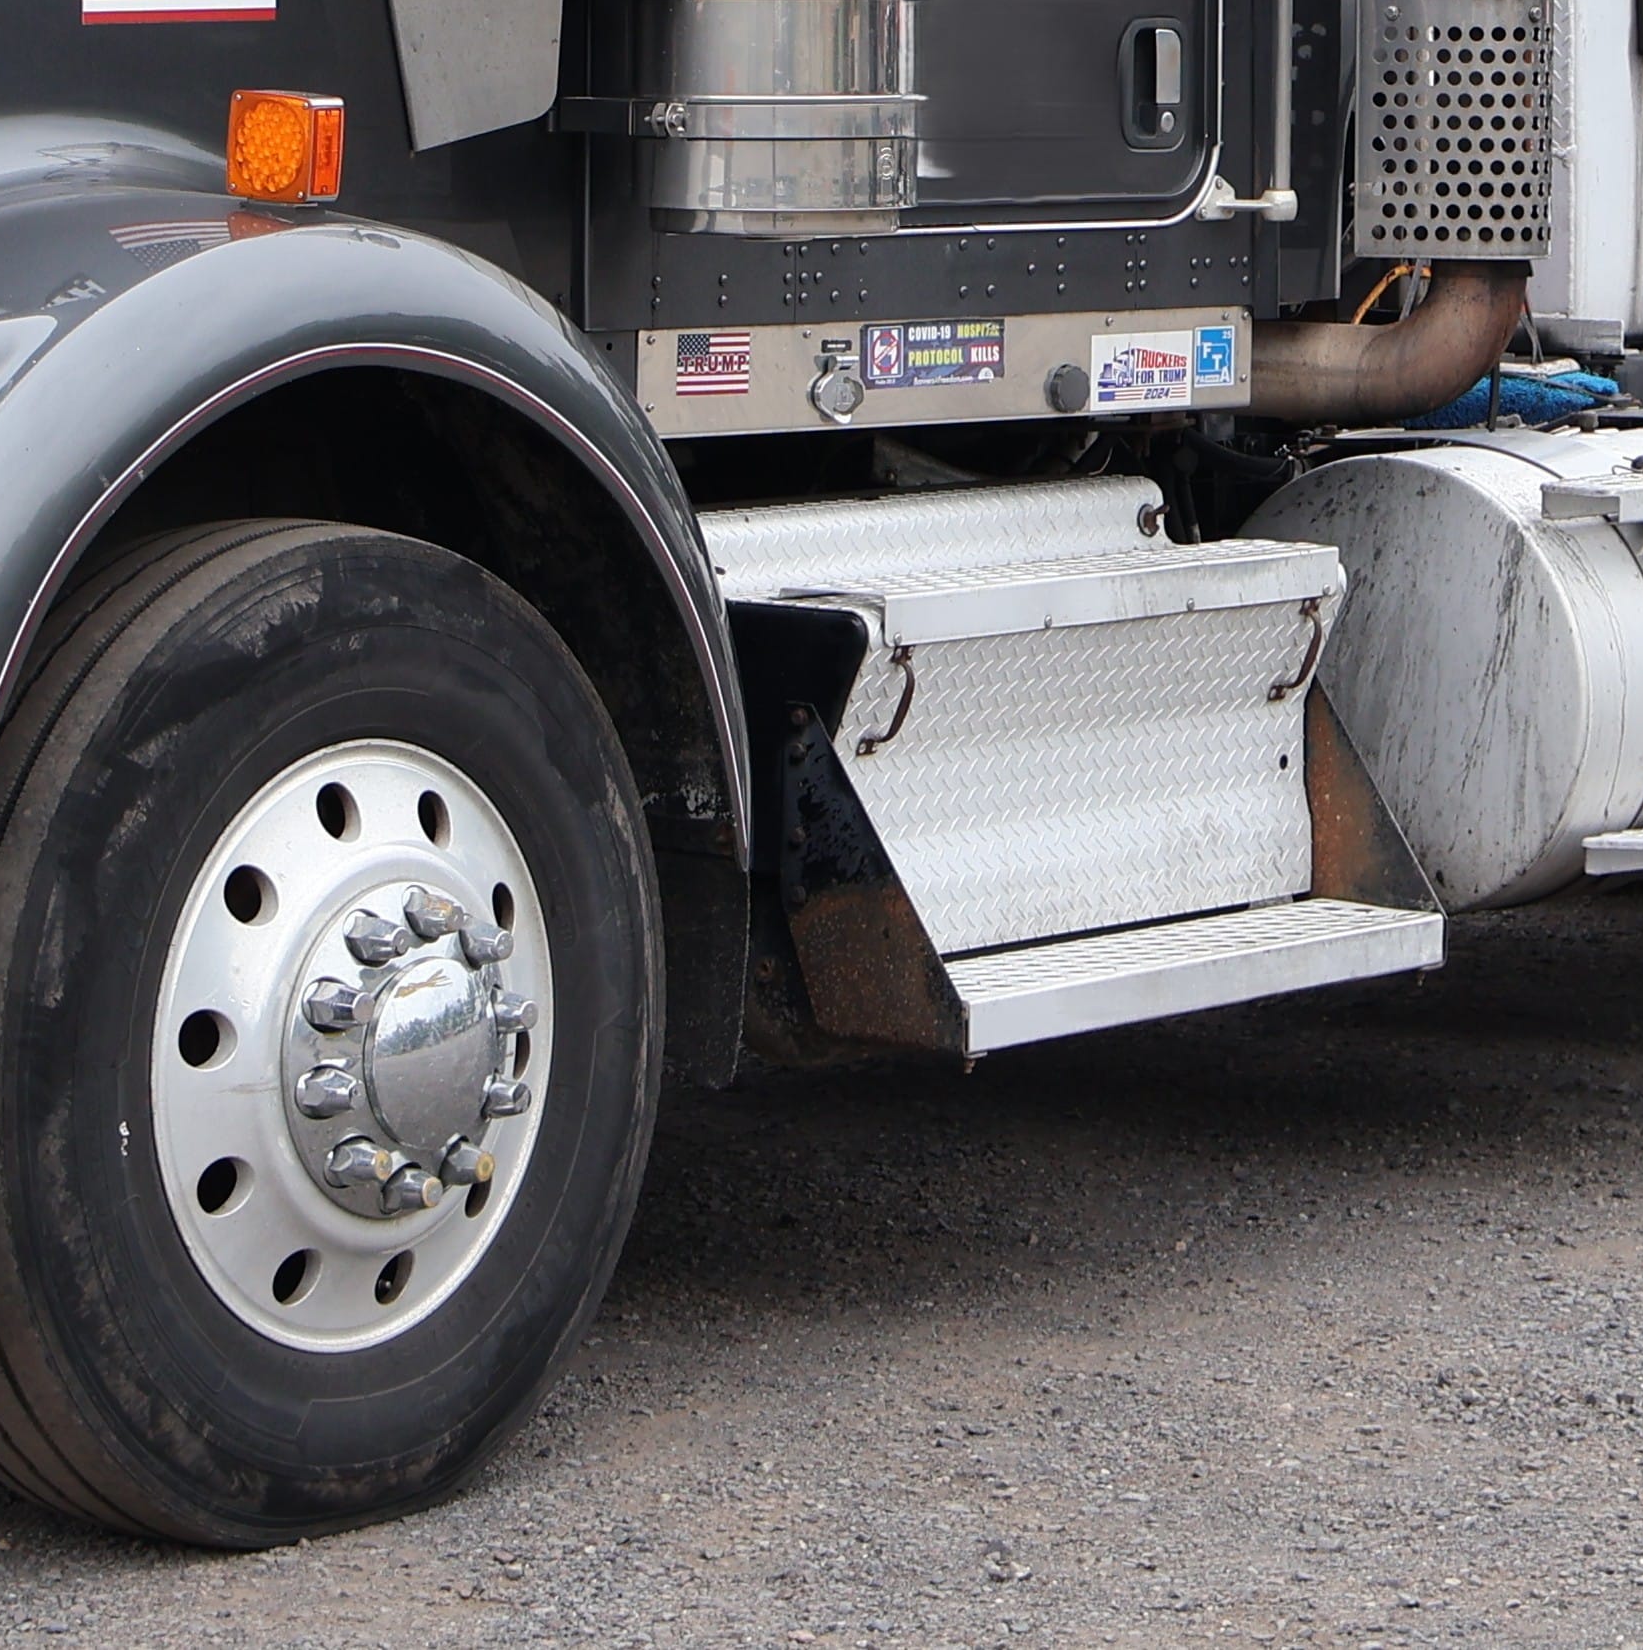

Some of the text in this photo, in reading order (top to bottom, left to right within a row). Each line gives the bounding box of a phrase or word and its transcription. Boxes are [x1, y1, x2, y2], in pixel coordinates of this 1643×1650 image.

[908, 325, 952, 342] COVID-19
[681, 353, 748, 374] TRUMP
[908, 345, 1000, 367] PROTOCOL KILLS
[1136, 348, 1187, 369] TRUCKERS
[1136, 369, 1187, 385] FOR TRUMP
[1144, 388, 1171, 400] 2024
